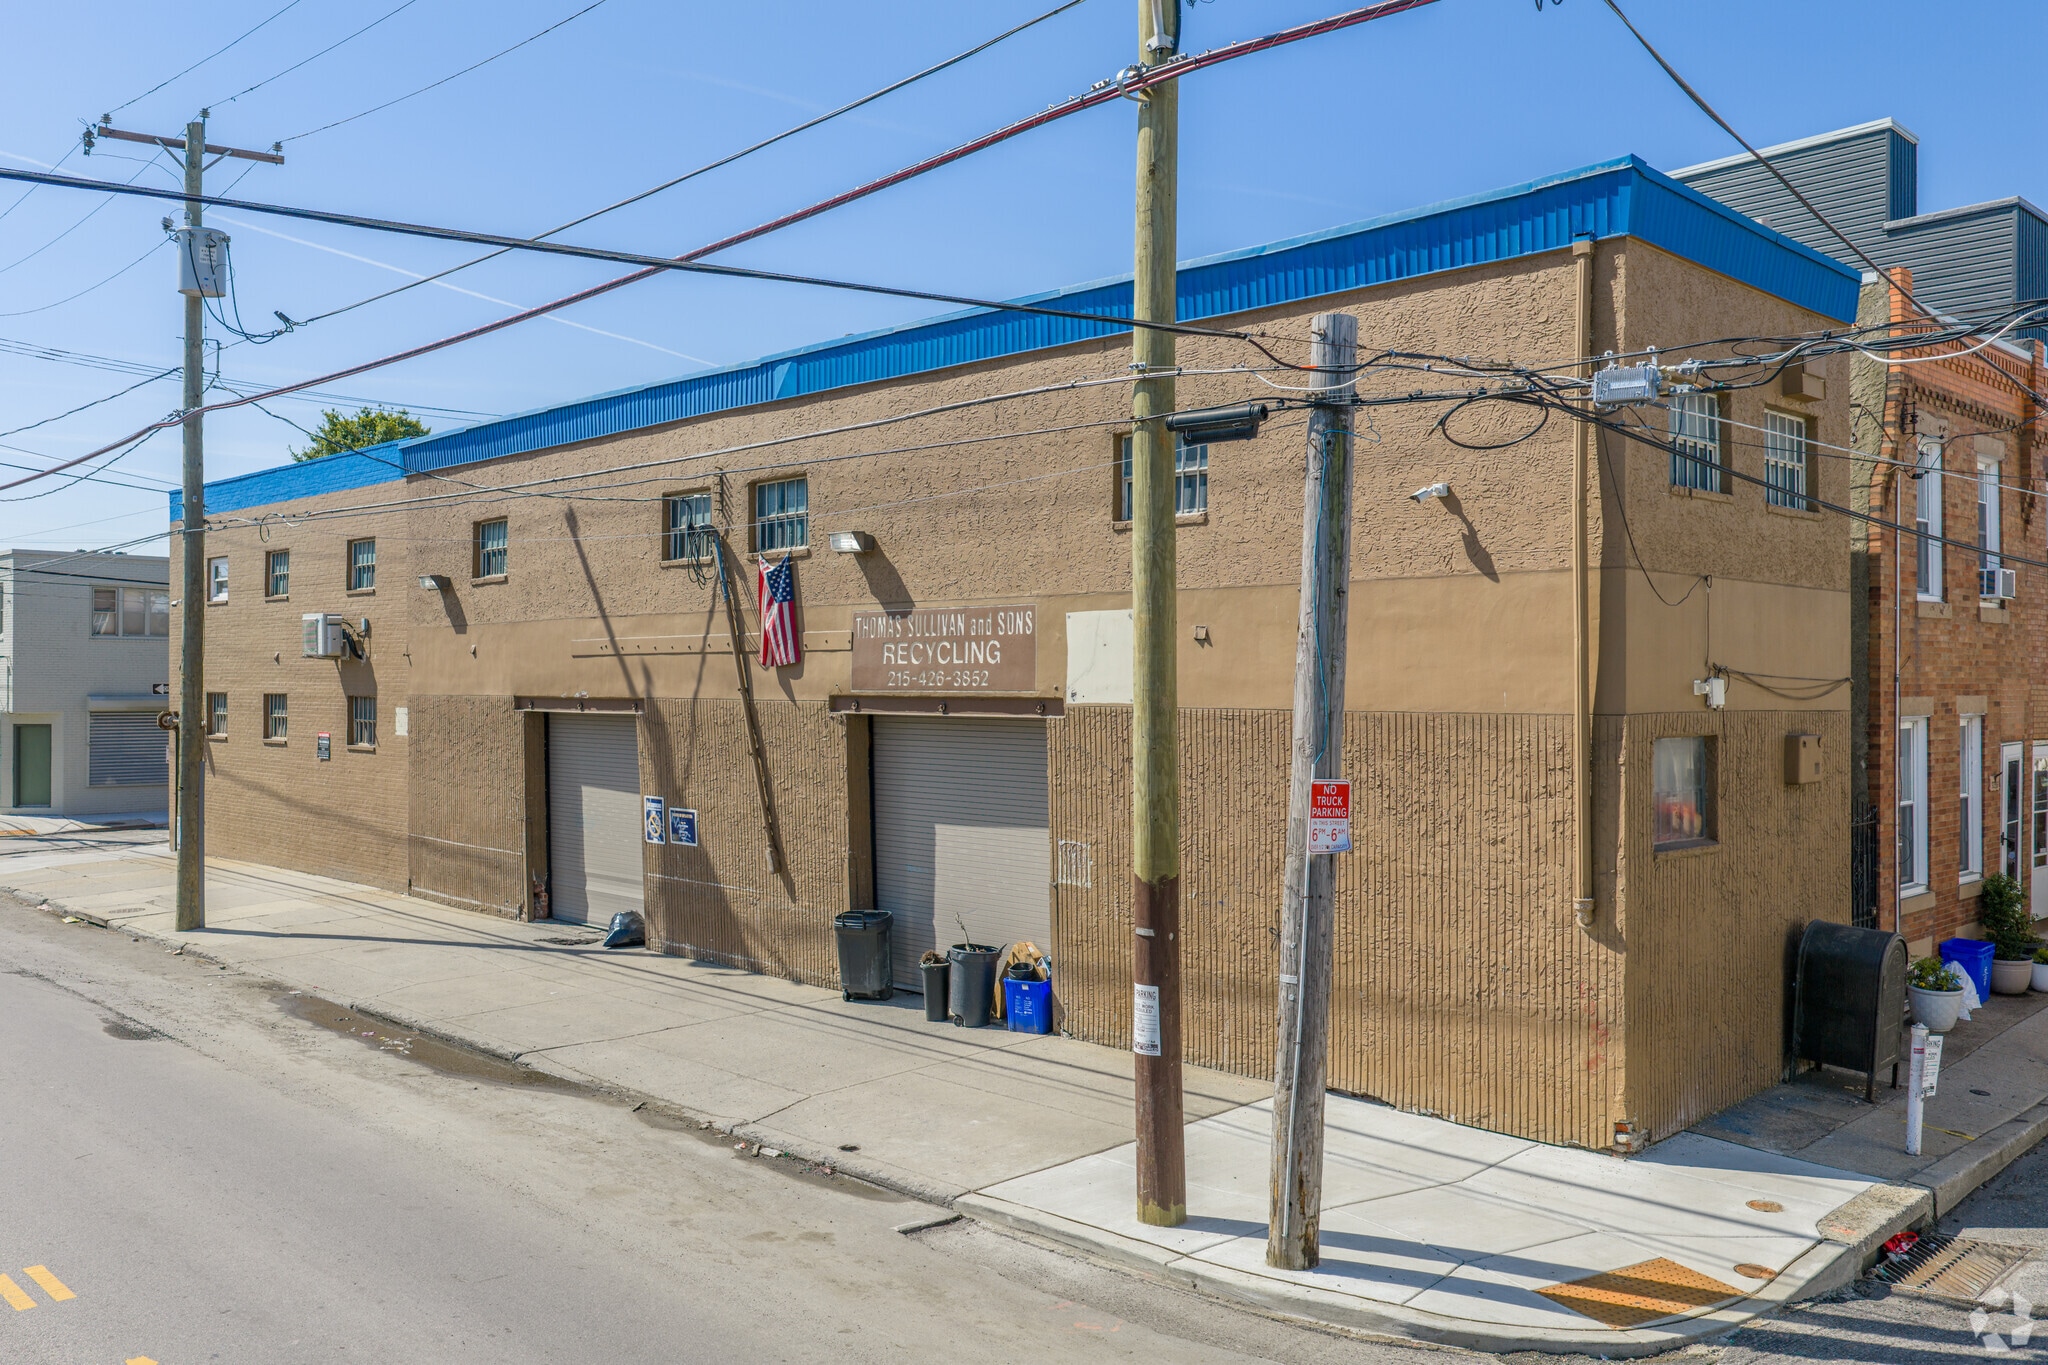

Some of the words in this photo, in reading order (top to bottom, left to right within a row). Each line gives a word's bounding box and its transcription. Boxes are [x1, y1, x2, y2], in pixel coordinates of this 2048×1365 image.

[855, 614, 902, 639] THOMAS
[906, 613, 965, 637] SULLIVAN
[970, 612, 992, 636] and
[997, 610, 1033, 635] SONS
[882, 640, 1001, 665] RECYCLING
[887, 669, 989, 687] 215-426-3852
[1323, 785, 1337, 795] NO
[1316, 796, 1343, 806] TRUCK
[1311, 807, 1347, 817] PARKING
